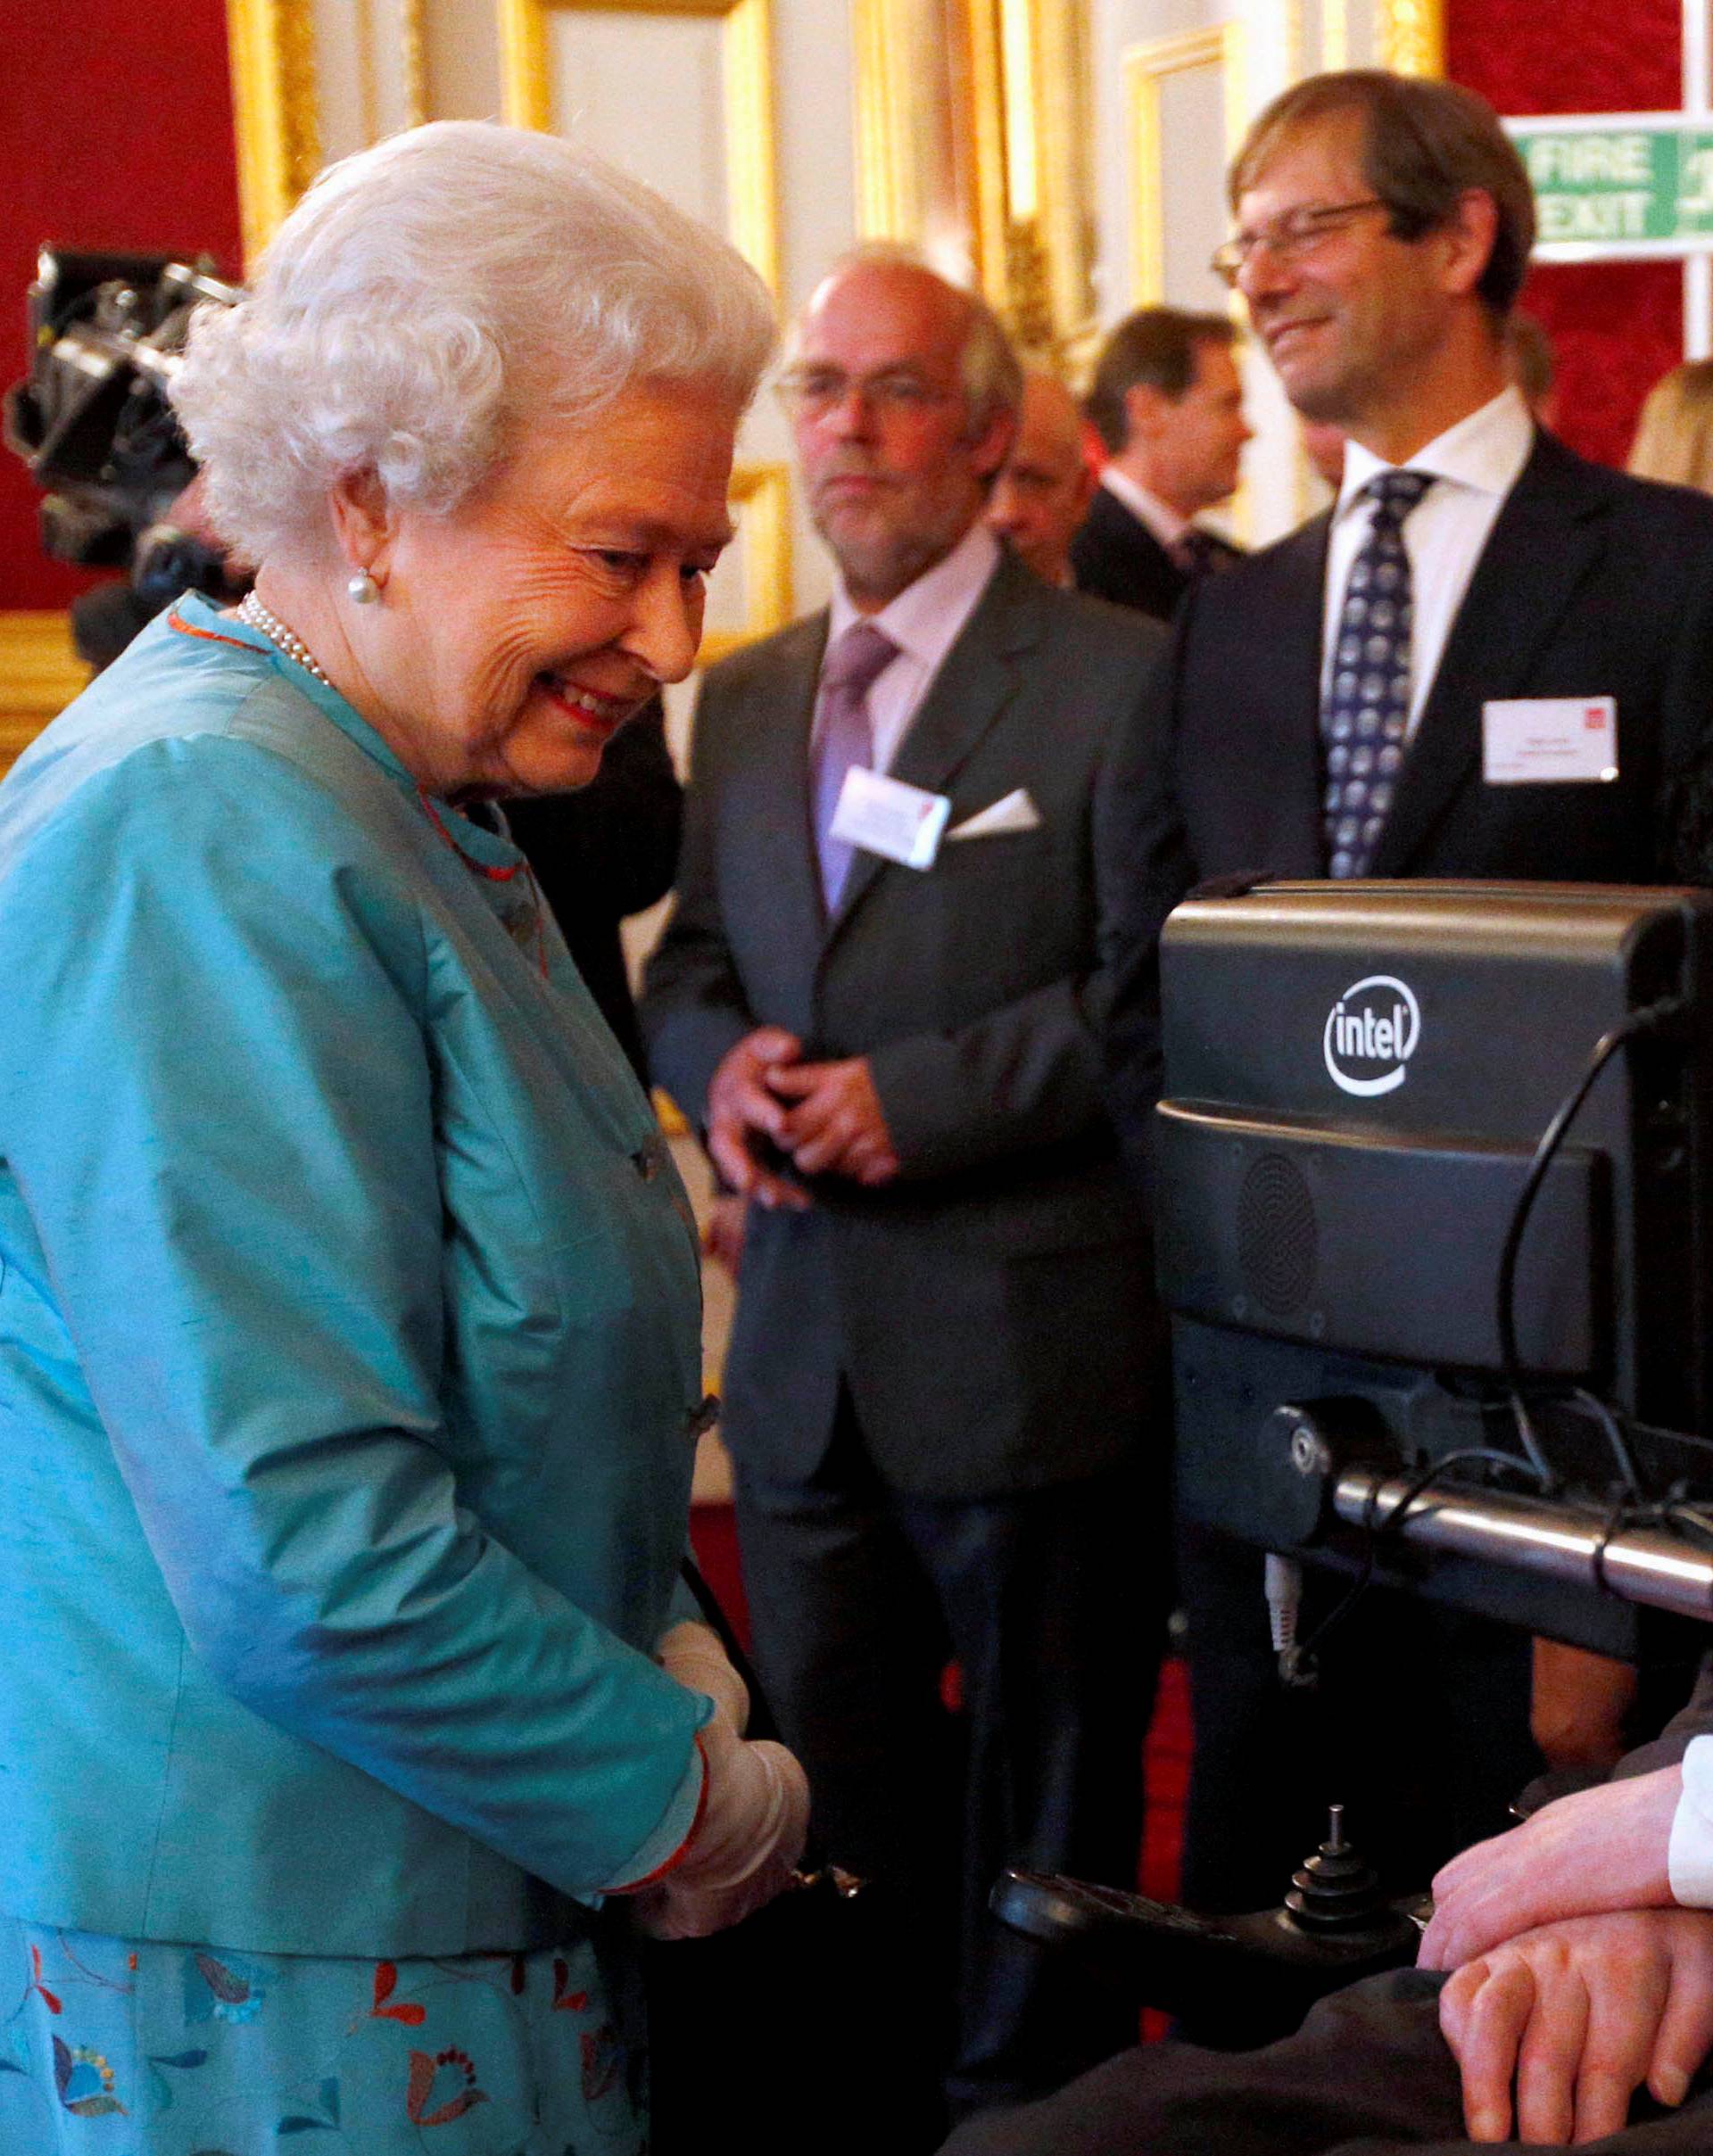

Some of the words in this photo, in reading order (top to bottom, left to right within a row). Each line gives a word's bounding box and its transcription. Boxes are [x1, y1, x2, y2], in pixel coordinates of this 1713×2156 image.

[1529, 138, 1650, 182] FIRE
[1538, 194, 1646, 236] EXIT
[1336, 1002, 1403, 1059] intel
